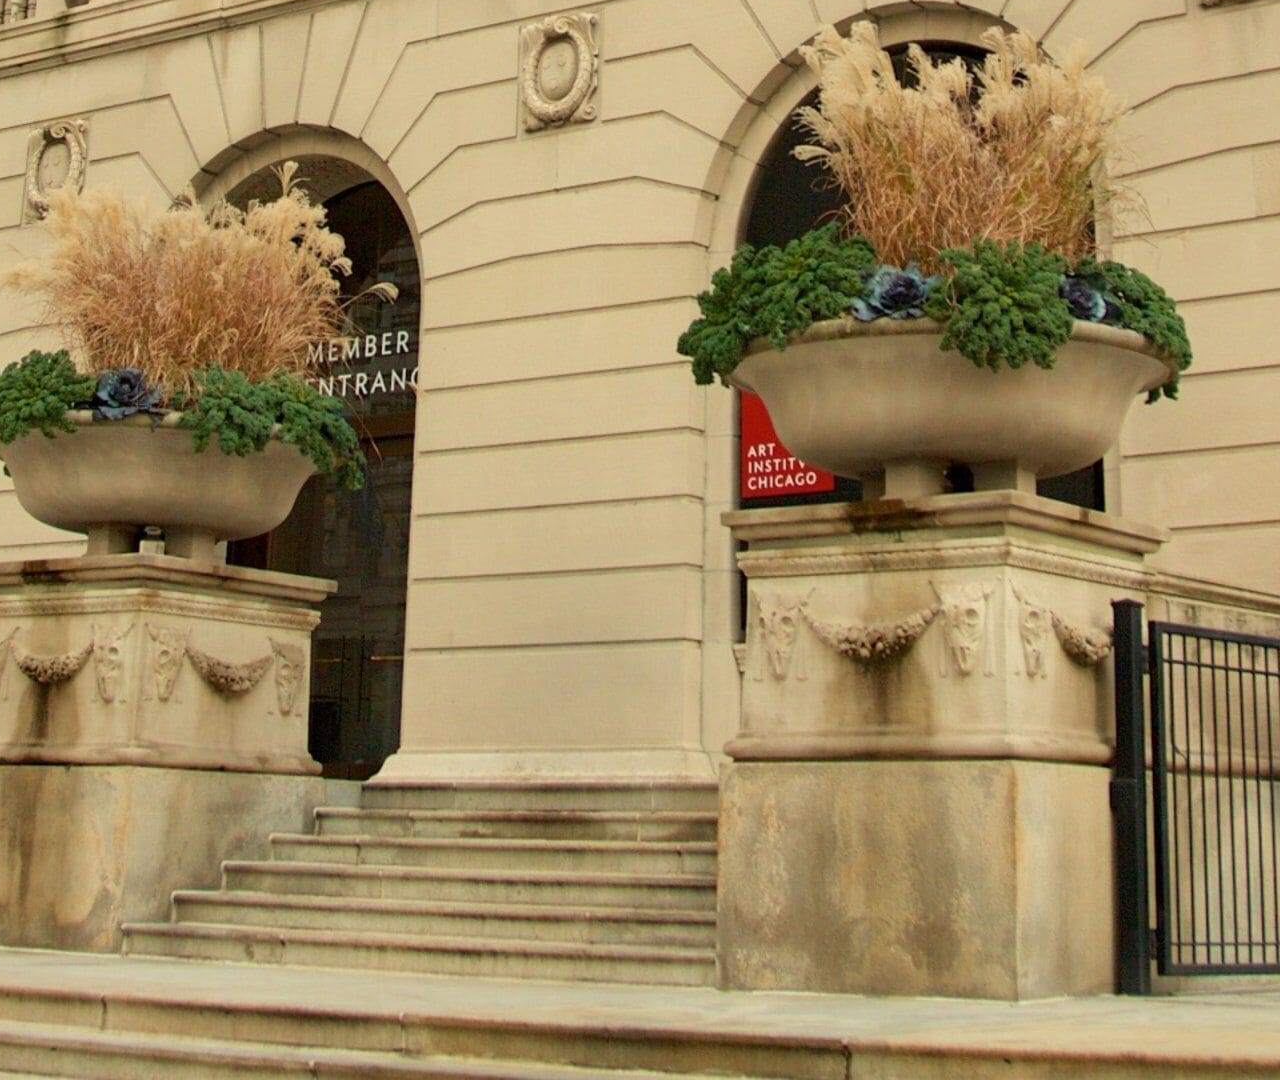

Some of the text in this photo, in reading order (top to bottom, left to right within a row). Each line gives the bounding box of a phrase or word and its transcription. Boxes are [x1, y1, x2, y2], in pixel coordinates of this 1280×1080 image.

[306, 330, 410, 365] MEMBER
[747, 443, 776, 458] ART
[747, 472, 817, 490] CHICAGO
